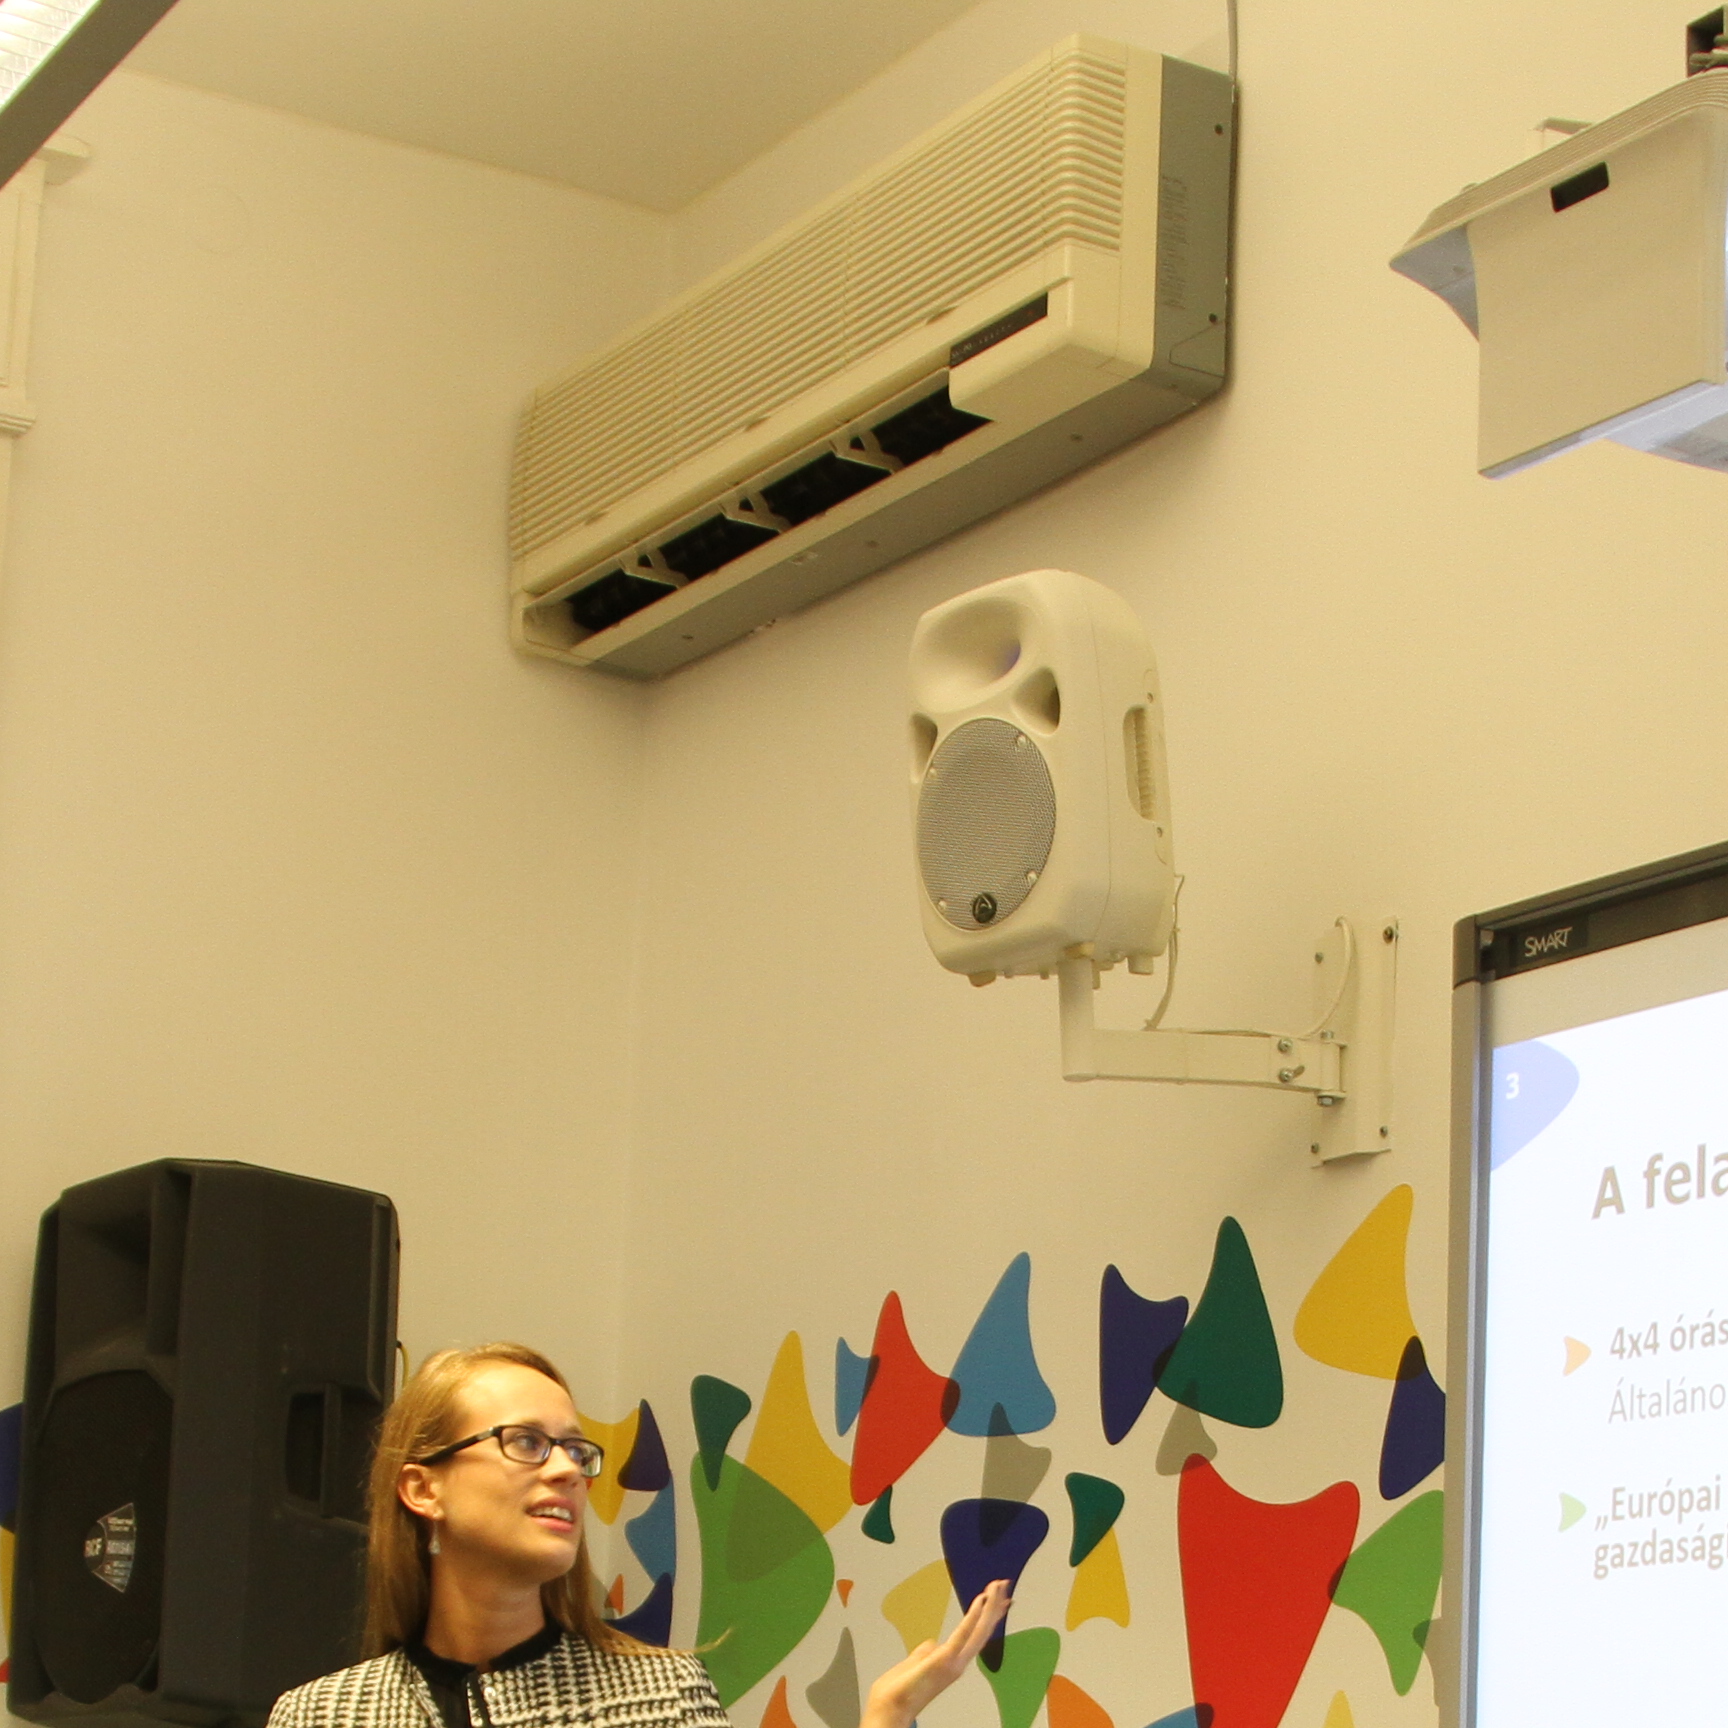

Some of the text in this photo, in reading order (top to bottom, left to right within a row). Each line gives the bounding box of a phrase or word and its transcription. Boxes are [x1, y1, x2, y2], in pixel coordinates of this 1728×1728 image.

[1524, 926, 1573, 957] SMART
[1505, 1072, 1520, 1099] 3
[1591, 1165, 1626, 1220] A
[1609, 1321, 1660, 1361] 4x4
[1594, 1474, 1722, 1532] „Európai
